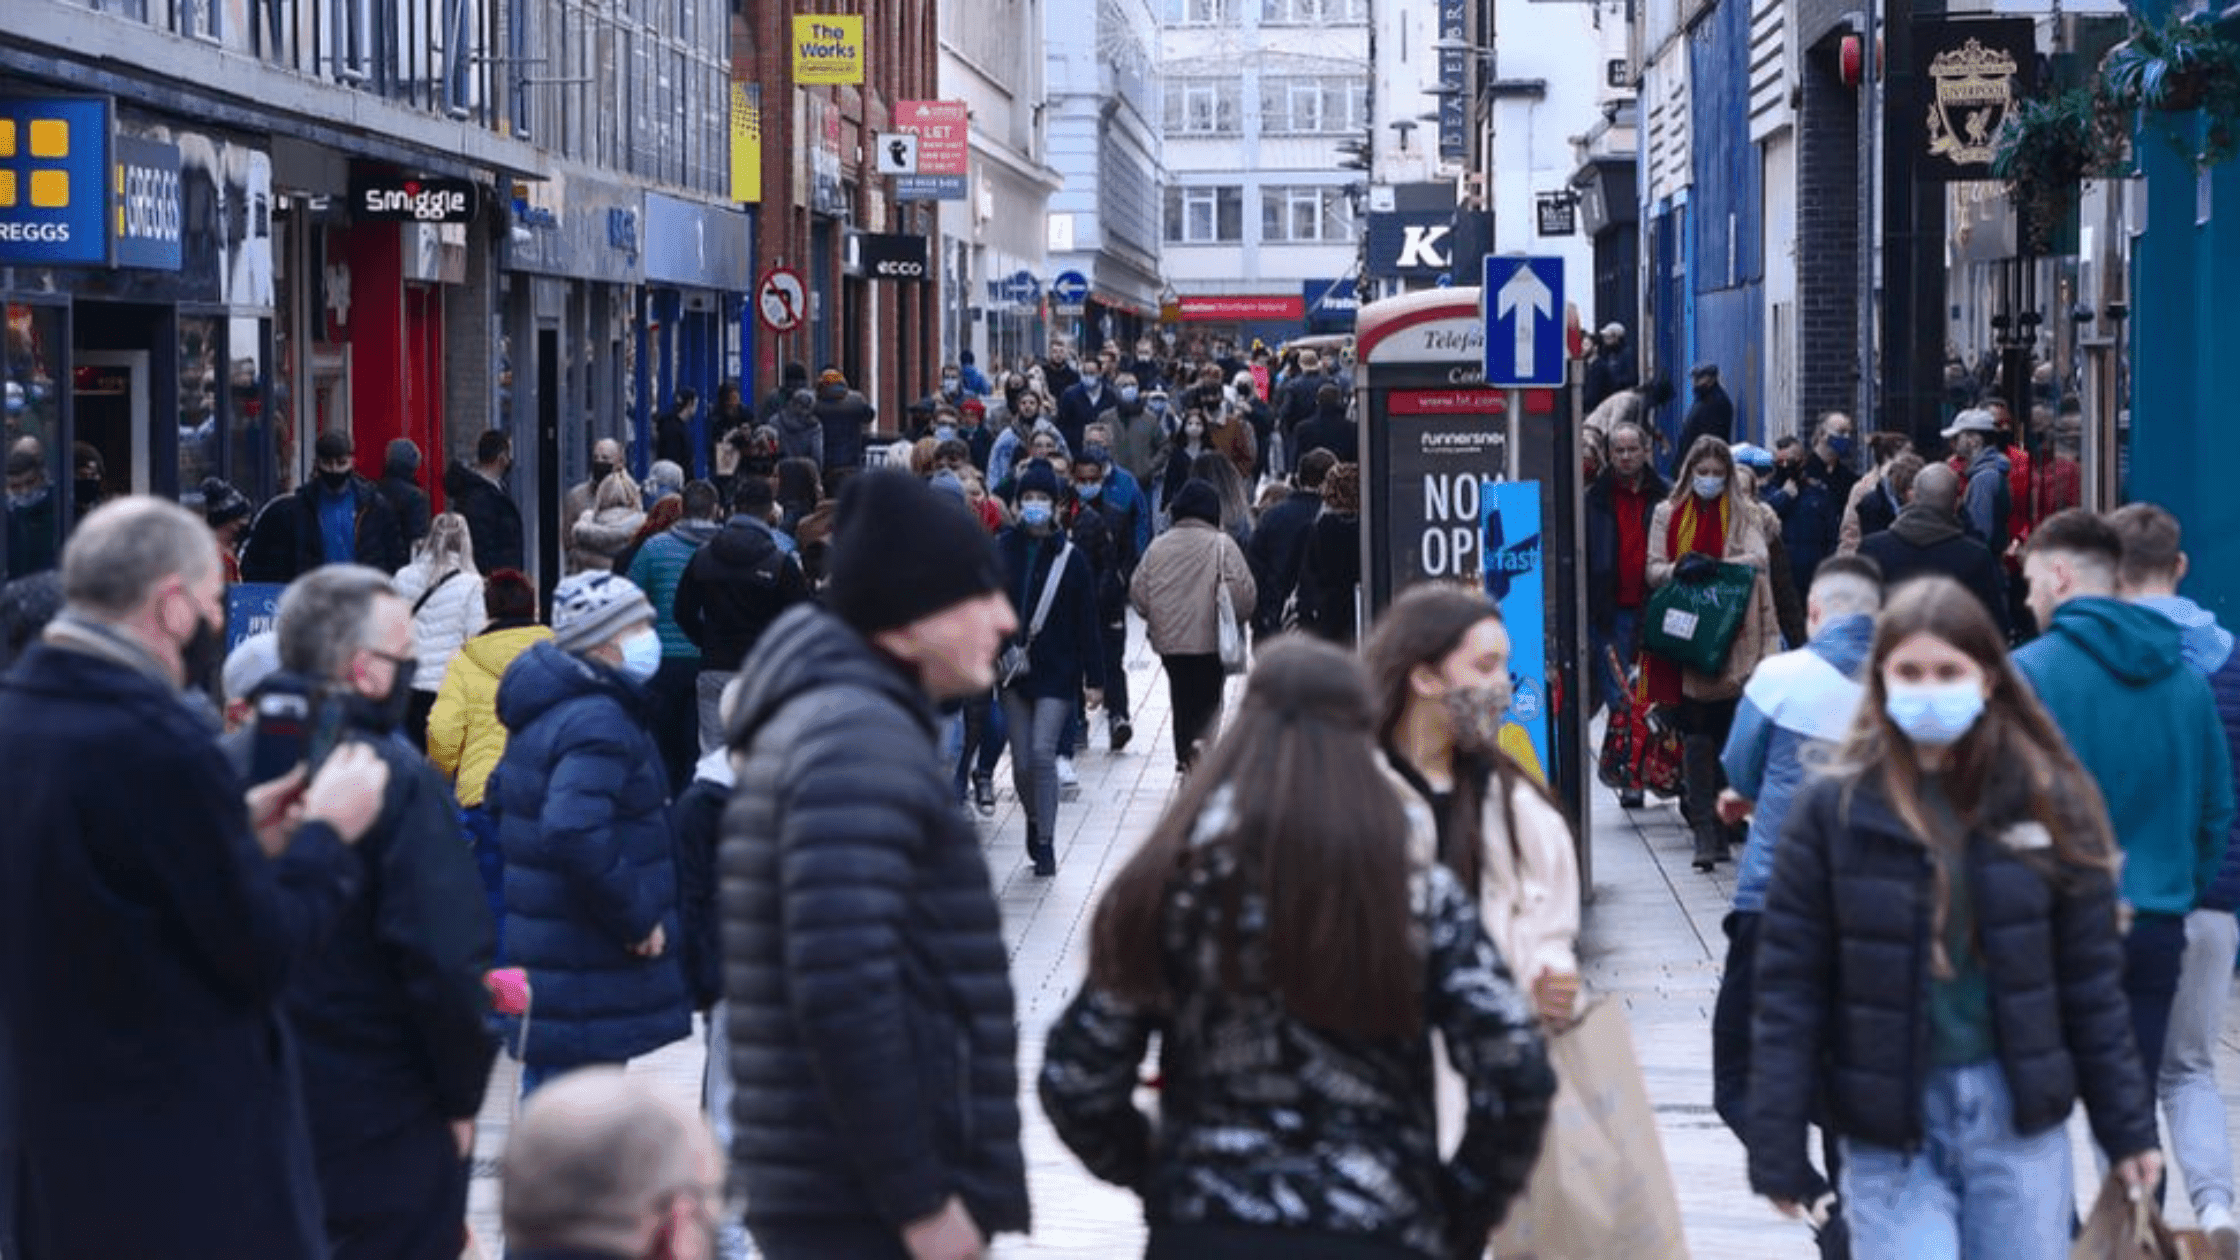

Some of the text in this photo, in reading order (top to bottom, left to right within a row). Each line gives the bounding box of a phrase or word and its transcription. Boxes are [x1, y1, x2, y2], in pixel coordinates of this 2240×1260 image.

[812, 24, 845, 40] The
[800, 41, 855, 58] Works
[923, 125, 953, 139] LET
[126, 165, 181, 241] GREGGS
[1396, 226, 1452, 267] K
[877, 261, 922, 276] ecco
[1424, 473, 1506, 521] NO
